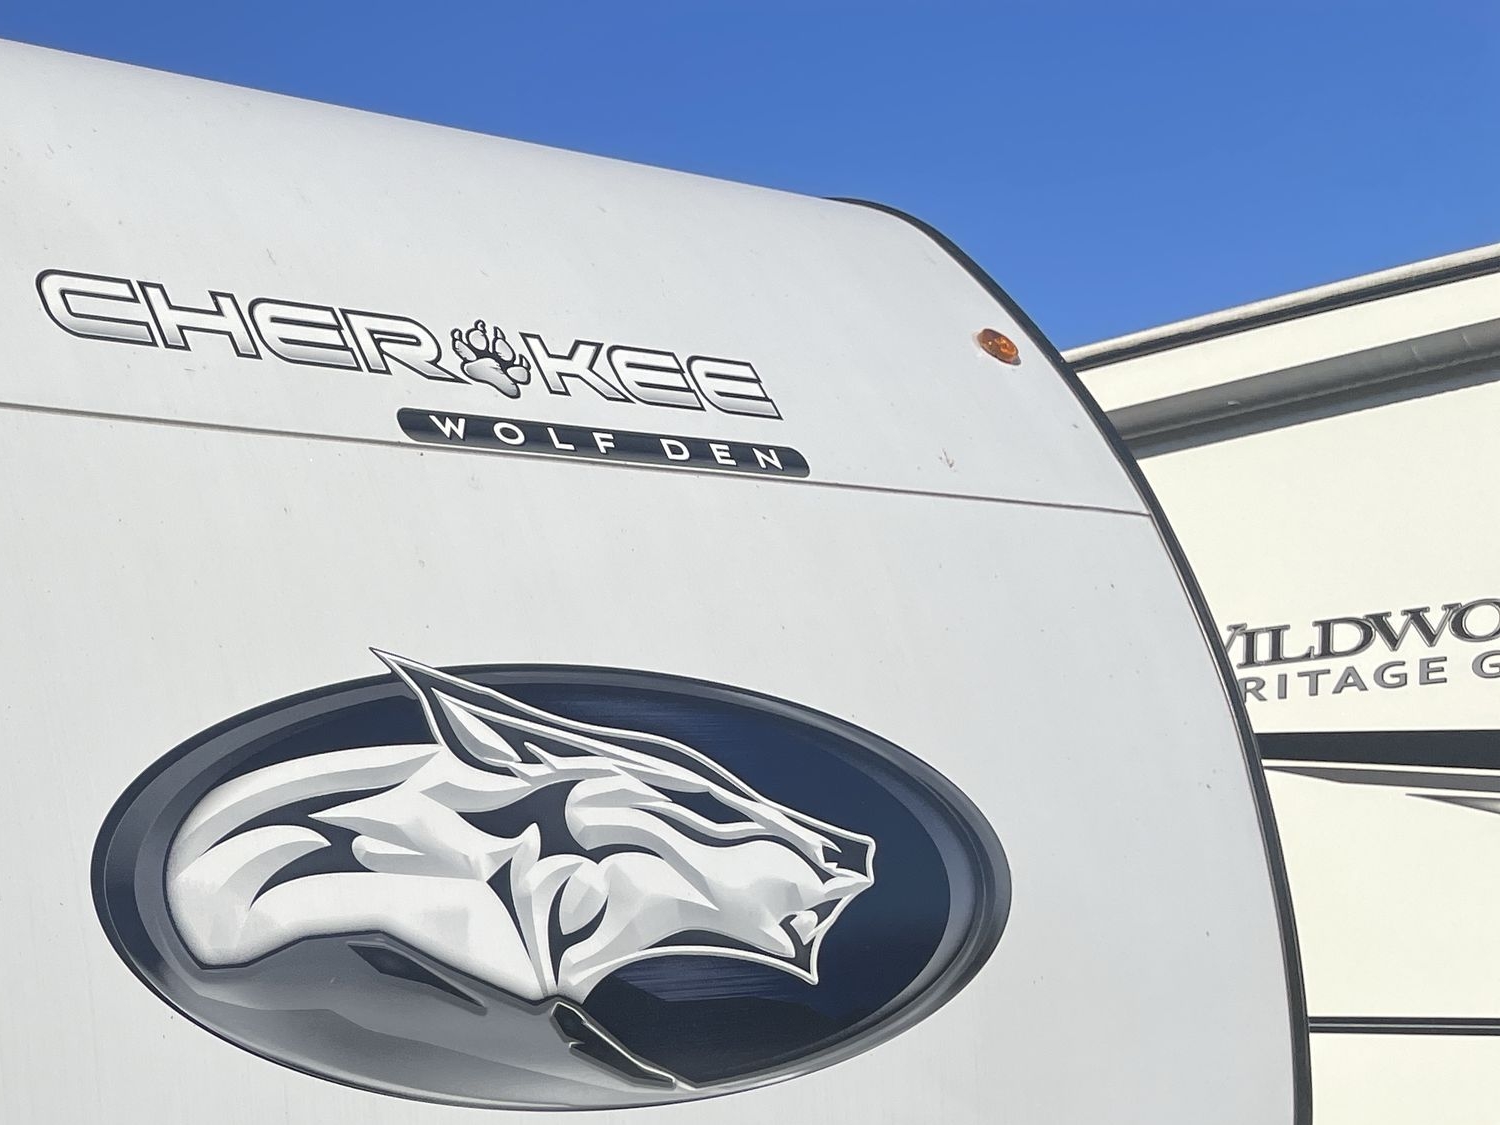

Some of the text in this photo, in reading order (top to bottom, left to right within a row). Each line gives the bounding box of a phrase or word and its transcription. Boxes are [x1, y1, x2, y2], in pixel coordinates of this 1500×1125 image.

[35, 269, 783, 420] CHEROKEE
[428, 413, 783, 471] WOLF DEN
